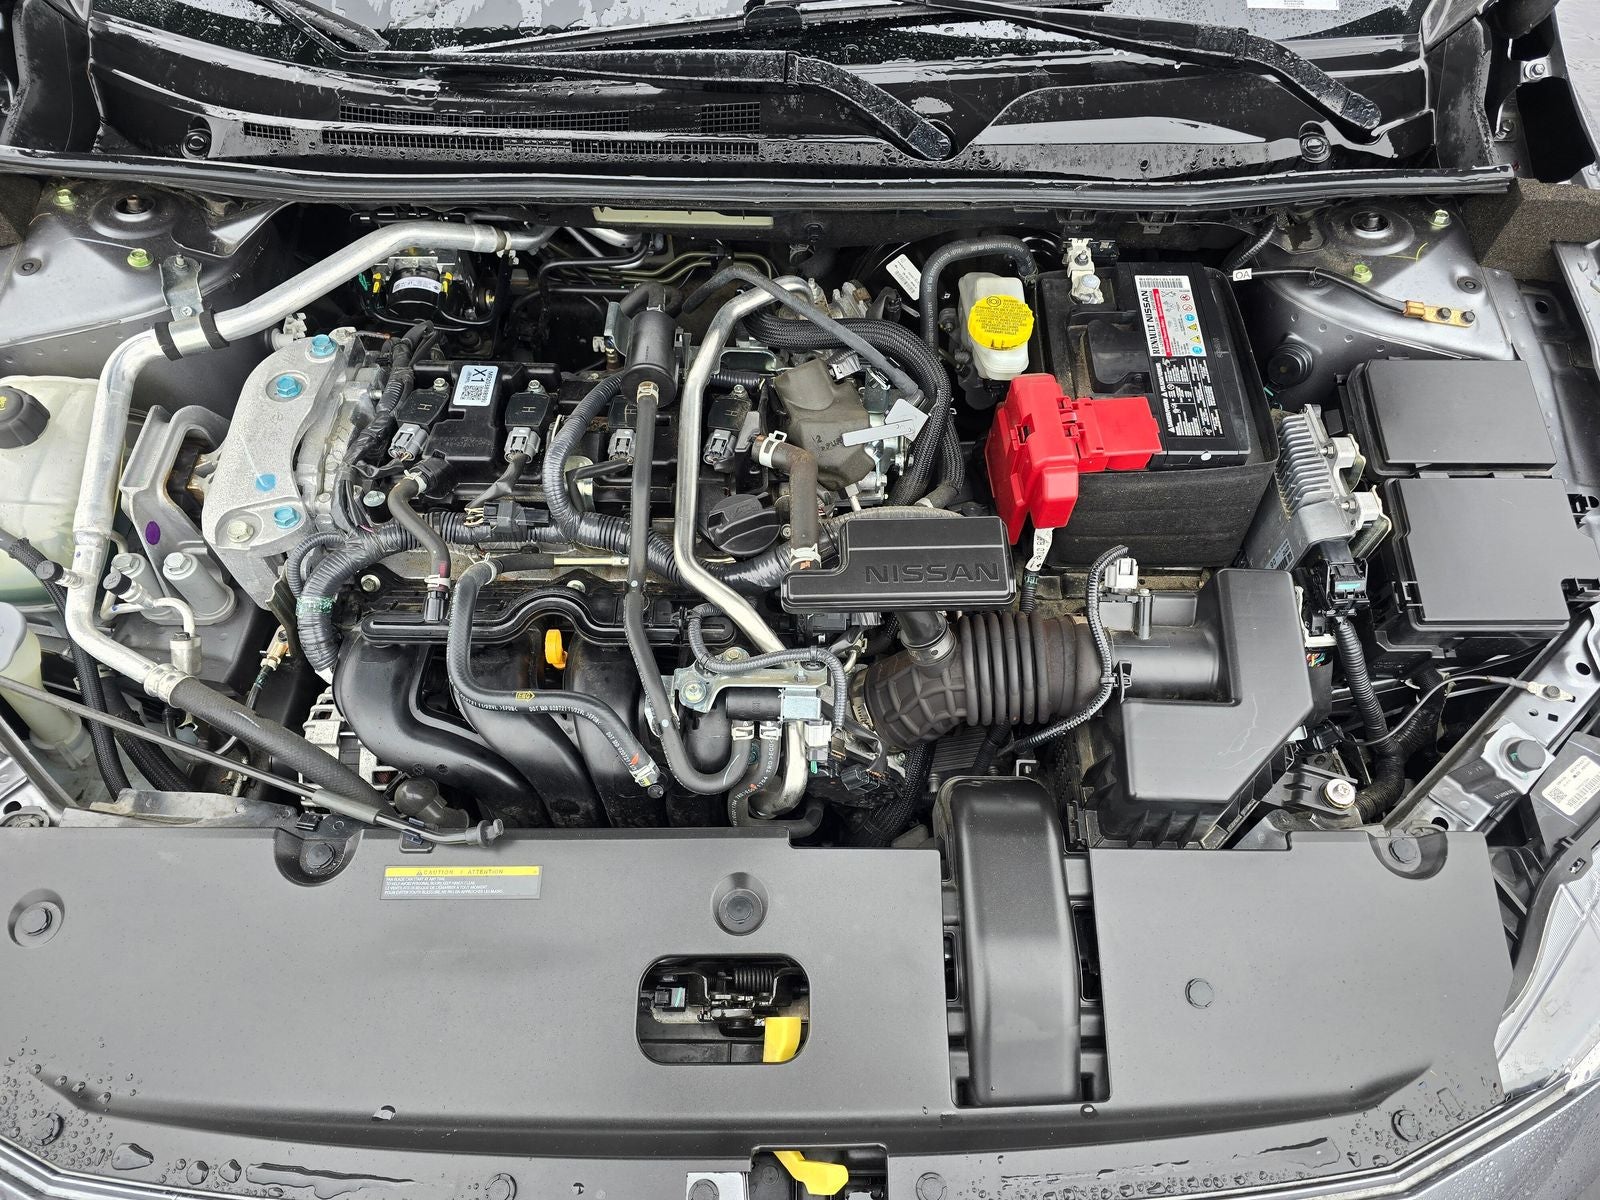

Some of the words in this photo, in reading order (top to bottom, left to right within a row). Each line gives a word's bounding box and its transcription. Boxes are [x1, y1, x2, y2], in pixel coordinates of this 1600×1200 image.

[1141, 289, 1154, 323] NISSAN
[1148, 324, 1160, 355] RENAULT
[471, 368, 488, 382] X1
[863, 563, 1001, 583] NISSAN
